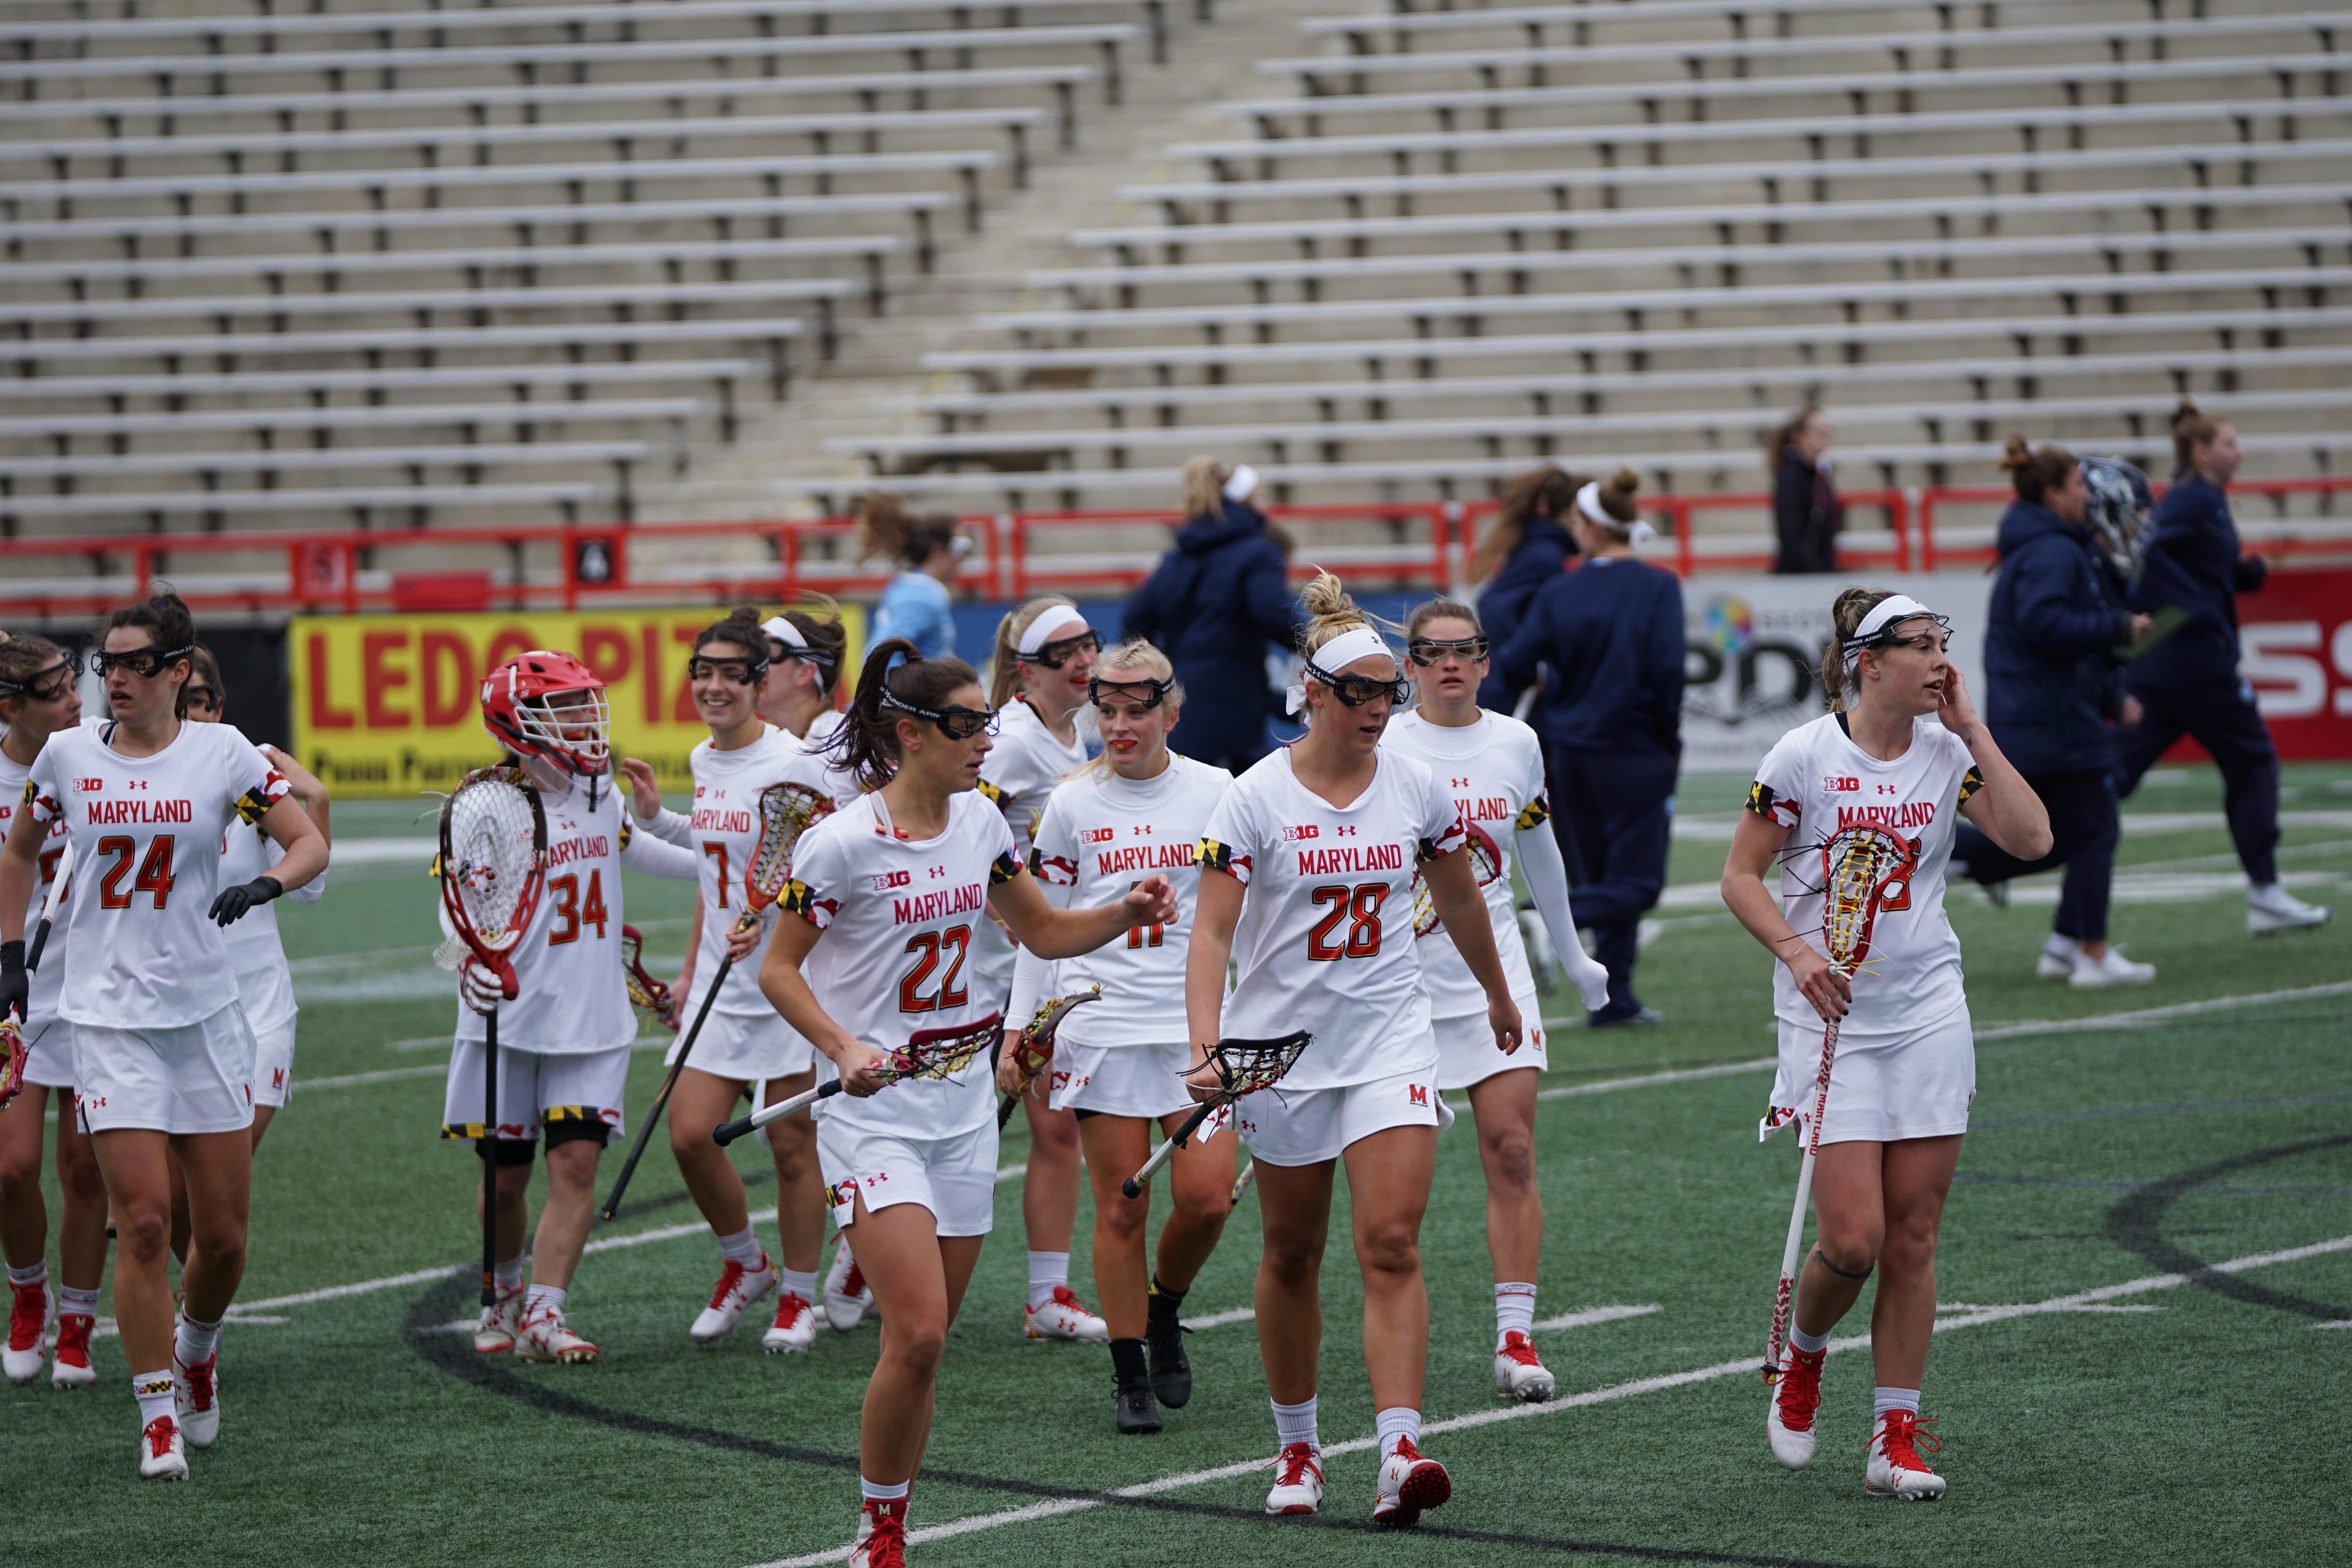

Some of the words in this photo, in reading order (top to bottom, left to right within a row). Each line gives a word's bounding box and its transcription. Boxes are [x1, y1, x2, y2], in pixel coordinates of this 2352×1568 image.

[1864, 633, 1883, 642] ARMO
[1321, 674, 1336, 684] UND
[889, 695, 916, 712] UNDER
[918, 710, 941, 718] ARM
[88, 800, 192, 825] MARYLAND
[1453, 797, 1508, 820] YLAND
[1838, 802, 1935, 831] MARYLAND
[98, 835, 177, 909] 24
[1098, 844, 1194, 875] MARYLAND
[1298, 844, 1402, 876] MARYLAND
[703, 841, 730, 909] 7
[548, 868, 608, 946] 34
[893, 883, 982, 924] MARYLAND
[1308, 882, 1390, 961] 28
[899, 924, 972, 1013] 22
[1530, 1028, 1542, 1049] M
[1409, 1083, 1428, 1105] M
[878, 1503, 891, 1516] M
